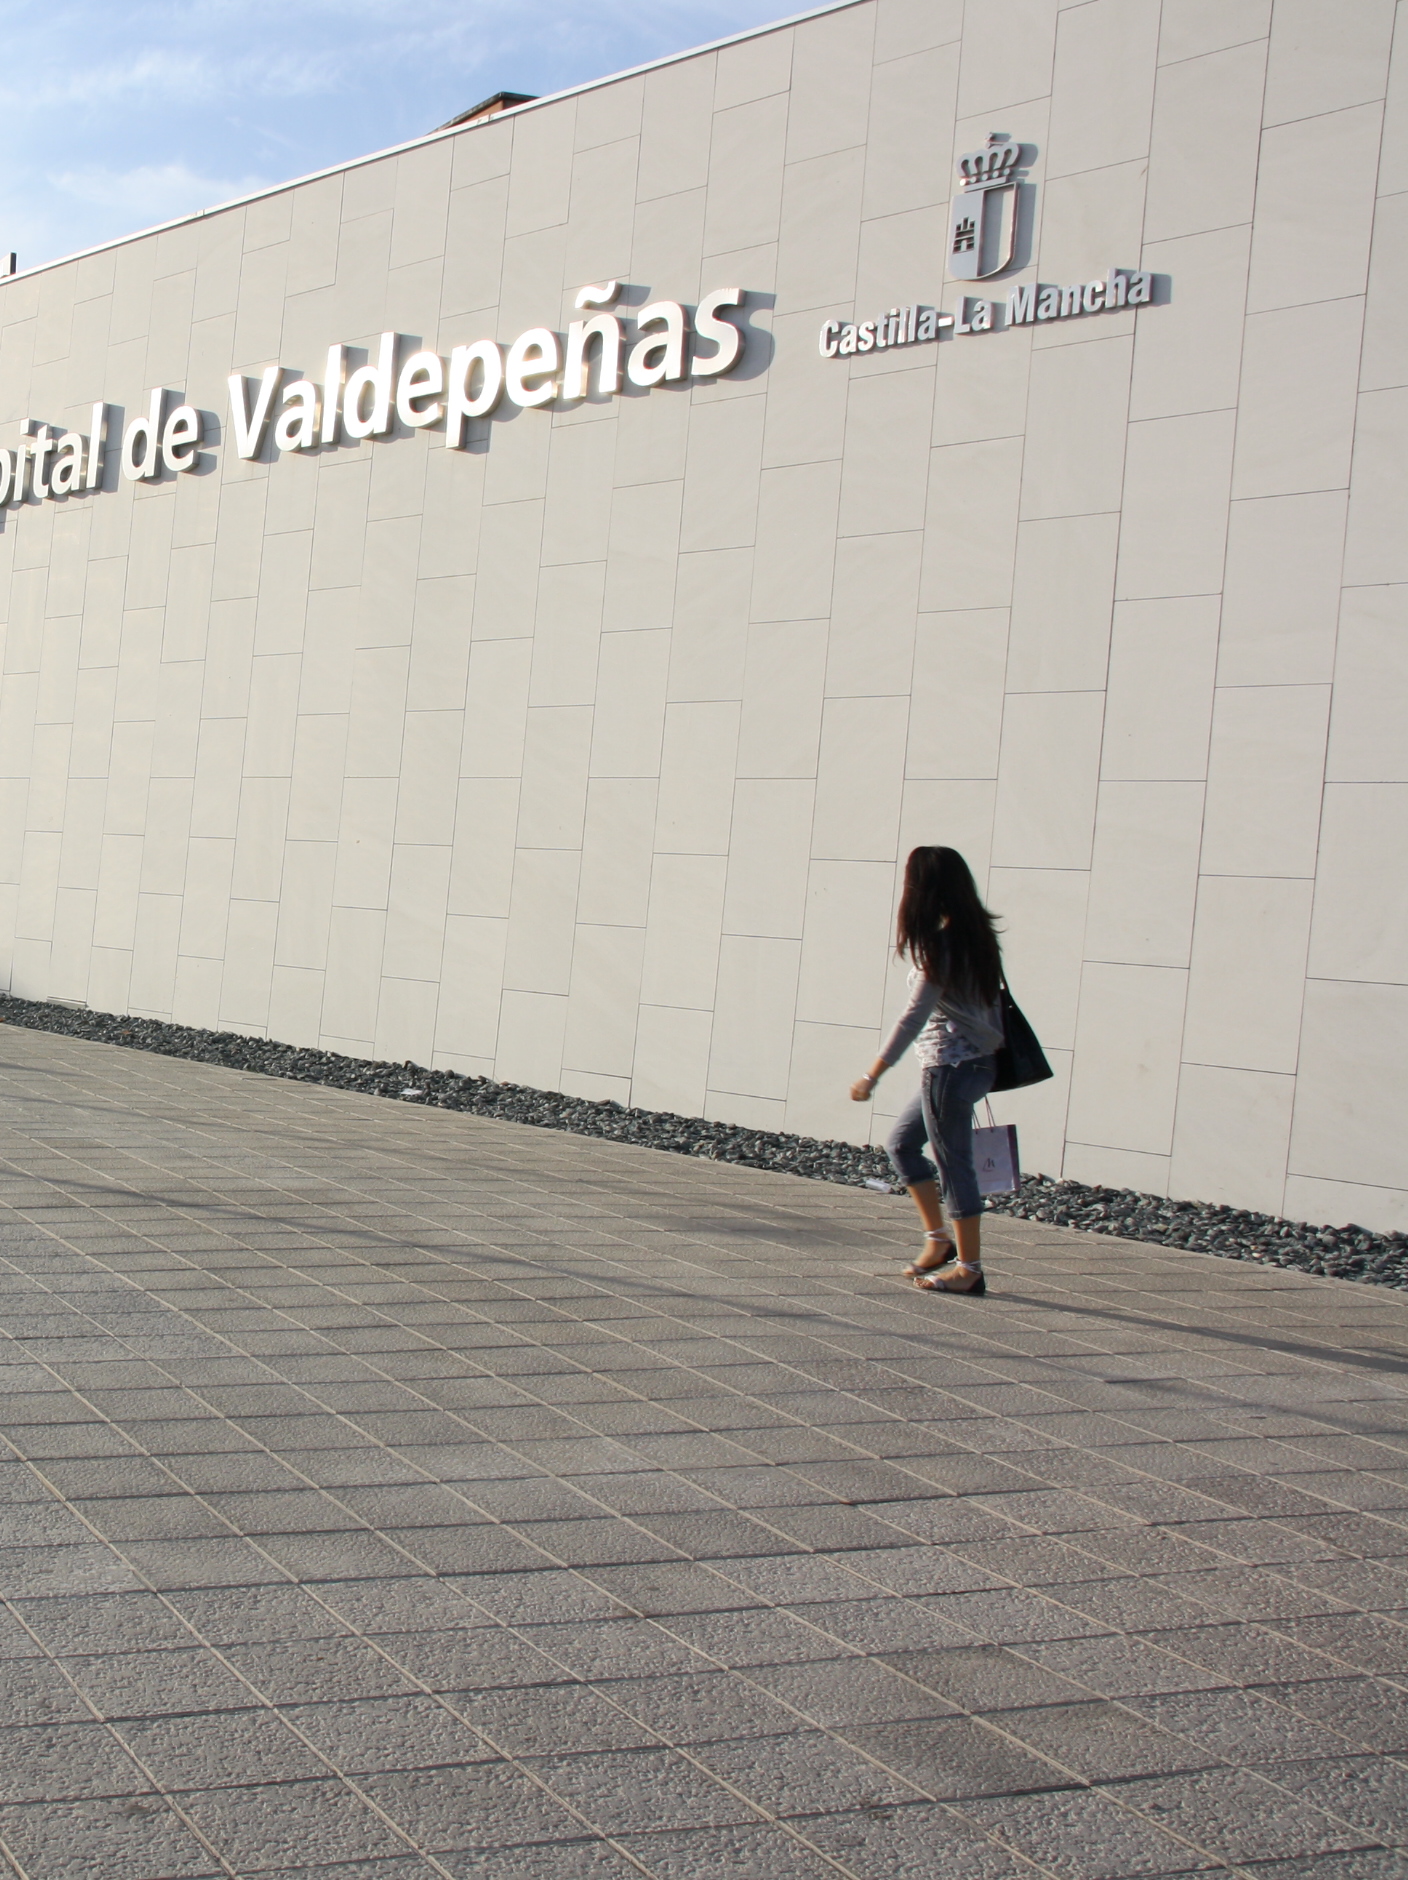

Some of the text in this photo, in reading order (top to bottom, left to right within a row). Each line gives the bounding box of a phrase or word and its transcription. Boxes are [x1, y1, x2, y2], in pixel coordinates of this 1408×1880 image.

[121, 386, 204, 482] de
[227, 280, 747, 460] Valdepeñas
[817, 267, 1154, 359] Castilla-La Mancha
